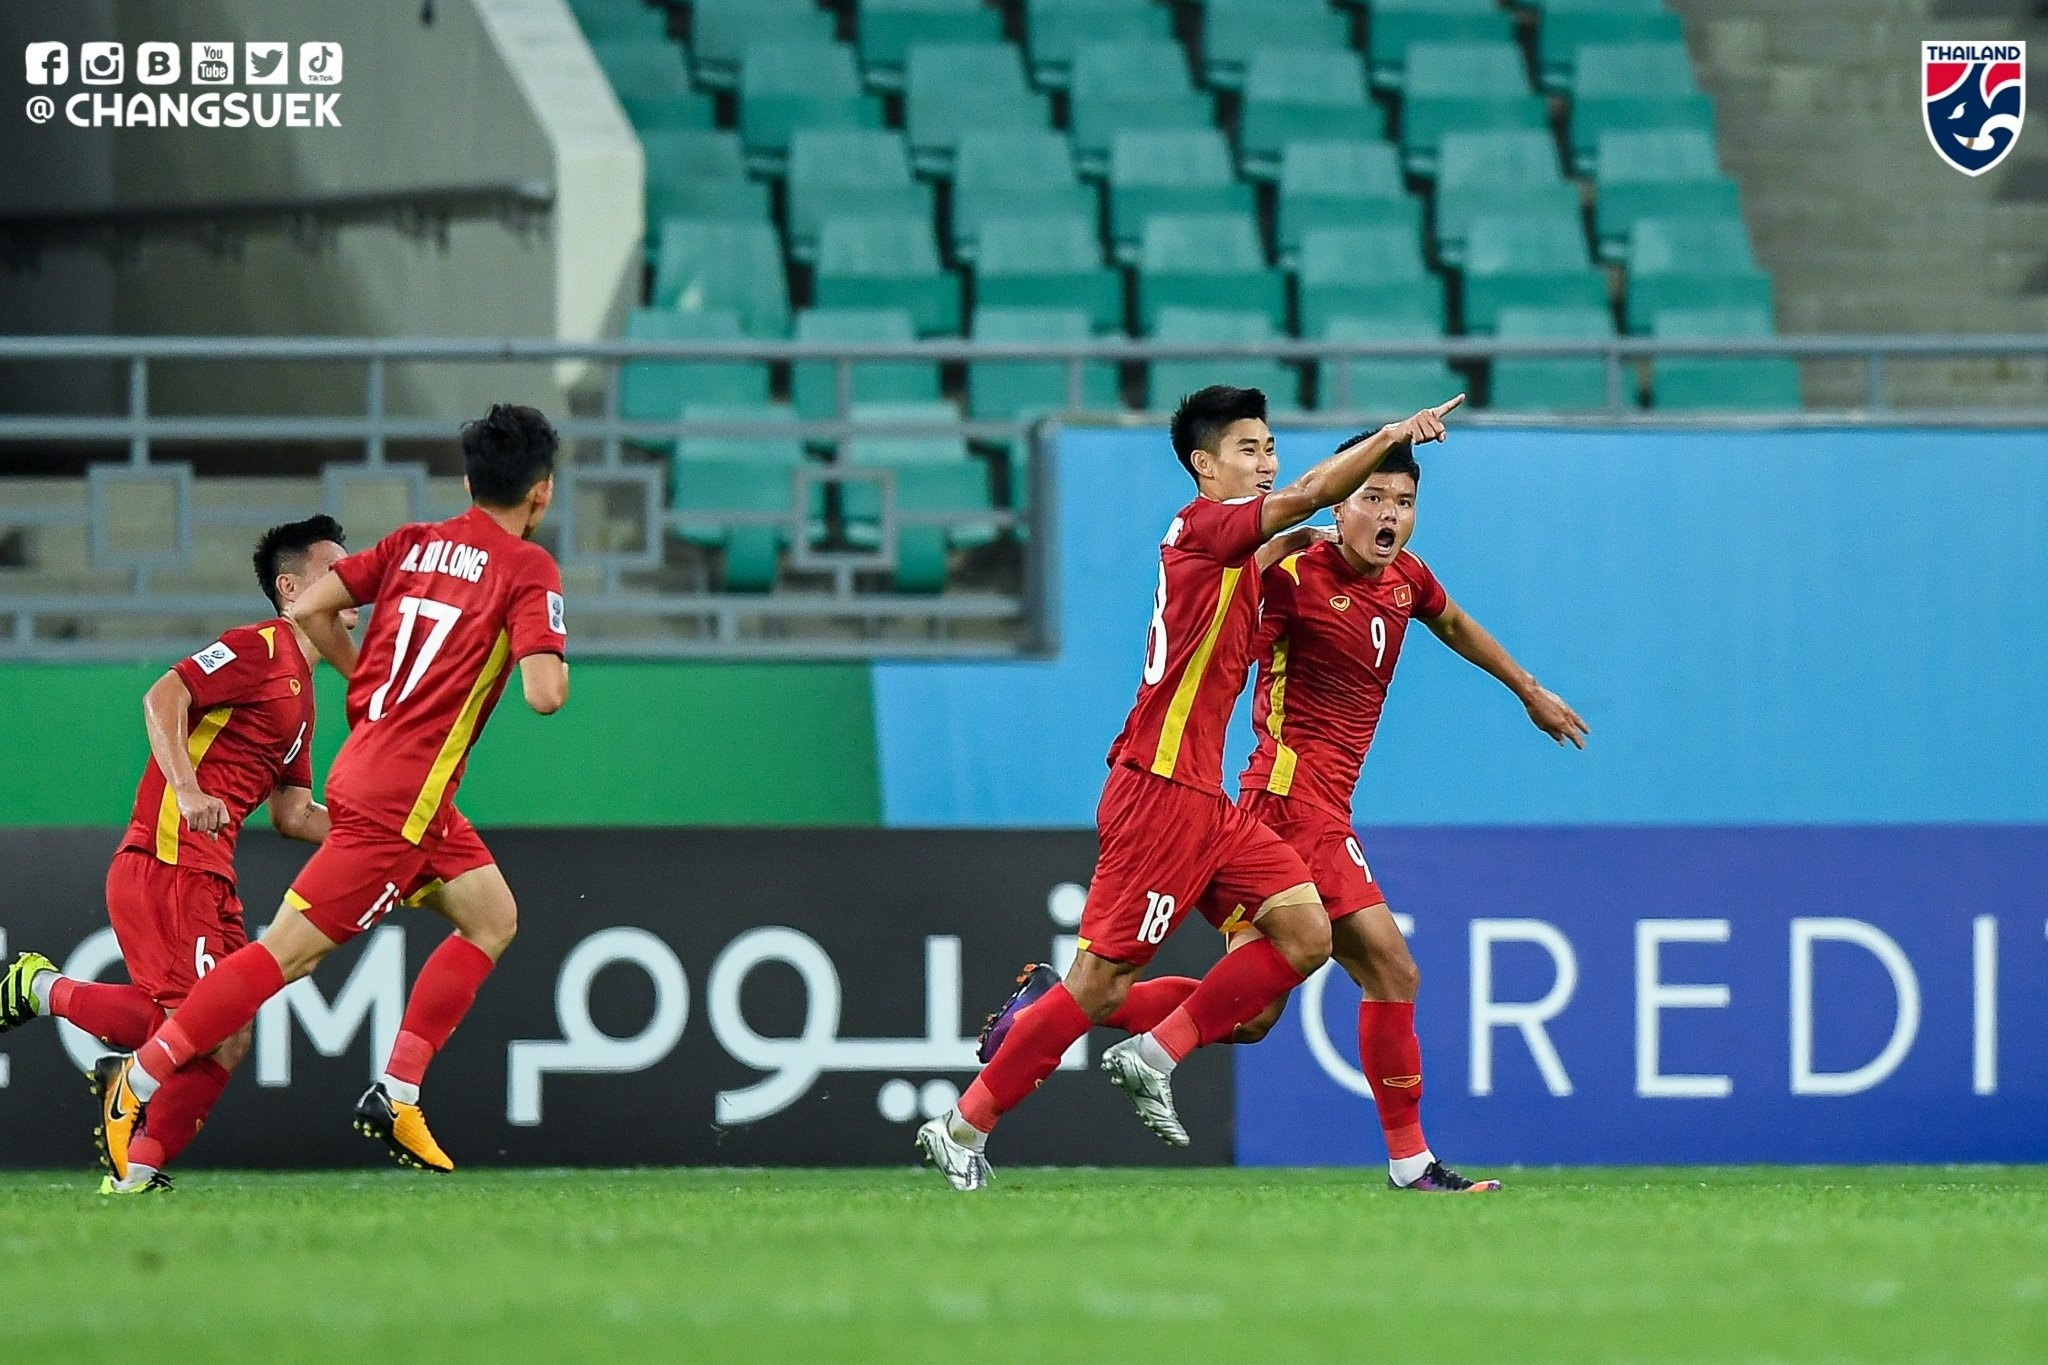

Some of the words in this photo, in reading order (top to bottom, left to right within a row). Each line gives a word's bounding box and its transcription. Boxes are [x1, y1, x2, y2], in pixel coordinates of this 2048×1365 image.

[437, 540, 489, 584] LONG
[368, 595, 463, 722] 17
[1370, 616, 1387, 669] 9
[282, 720, 308, 766] 6
[1345, 836, 1374, 884] 9
[1136, 890, 1176, 945] 18
